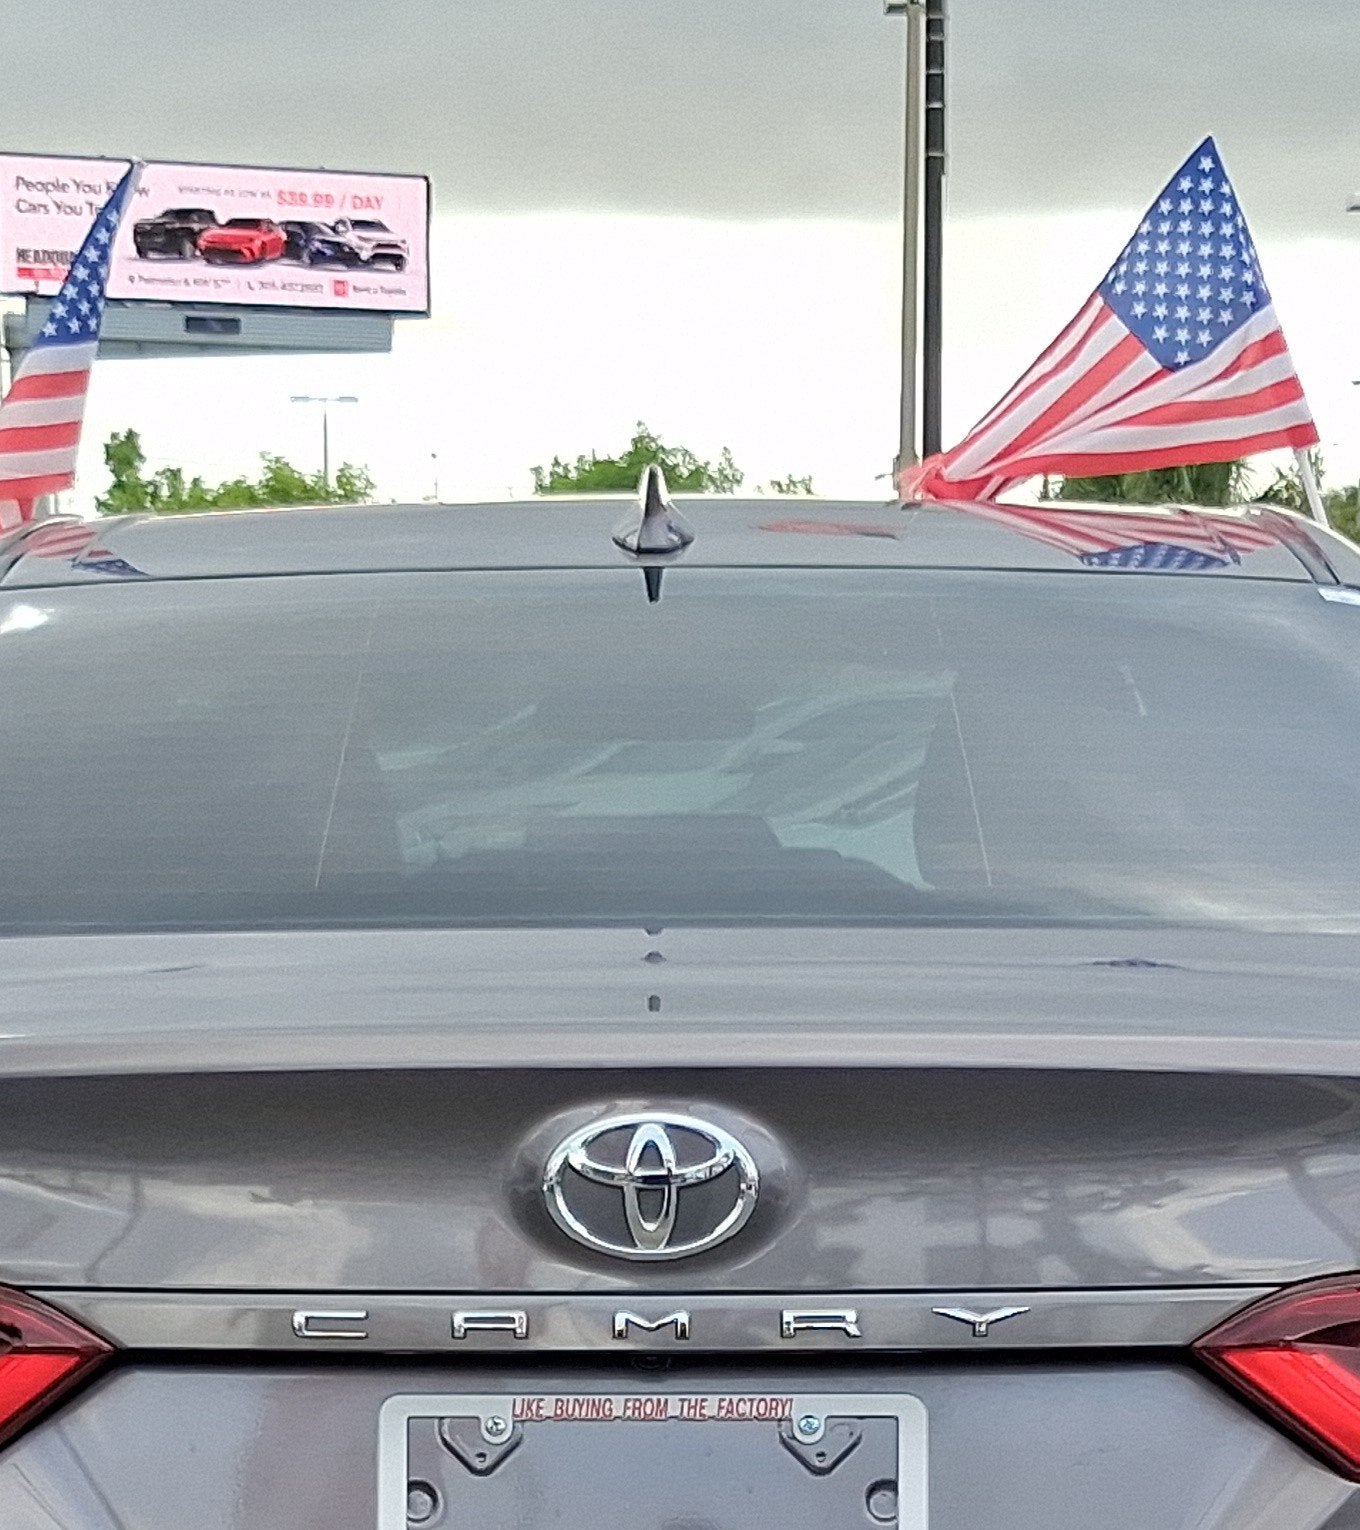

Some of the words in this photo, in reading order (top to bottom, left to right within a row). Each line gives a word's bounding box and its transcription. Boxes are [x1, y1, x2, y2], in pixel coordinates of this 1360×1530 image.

[15, 175, 70, 195] People
[71, 178, 101, 195] You
[15, 198, 50, 215] Cars
[51, 200, 83, 216] You
[351, 194, 384, 210] DAY
[291, 1305, 1031, 1340] CAMRY
[512, 1397, 546, 1419] LIKE
[552, 1397, 614, 1419] BUYING
[621, 1397, 669, 1419] FROM
[678, 1397, 710, 1419] THE
[716, 1397, 794, 1419] FACTORY!
